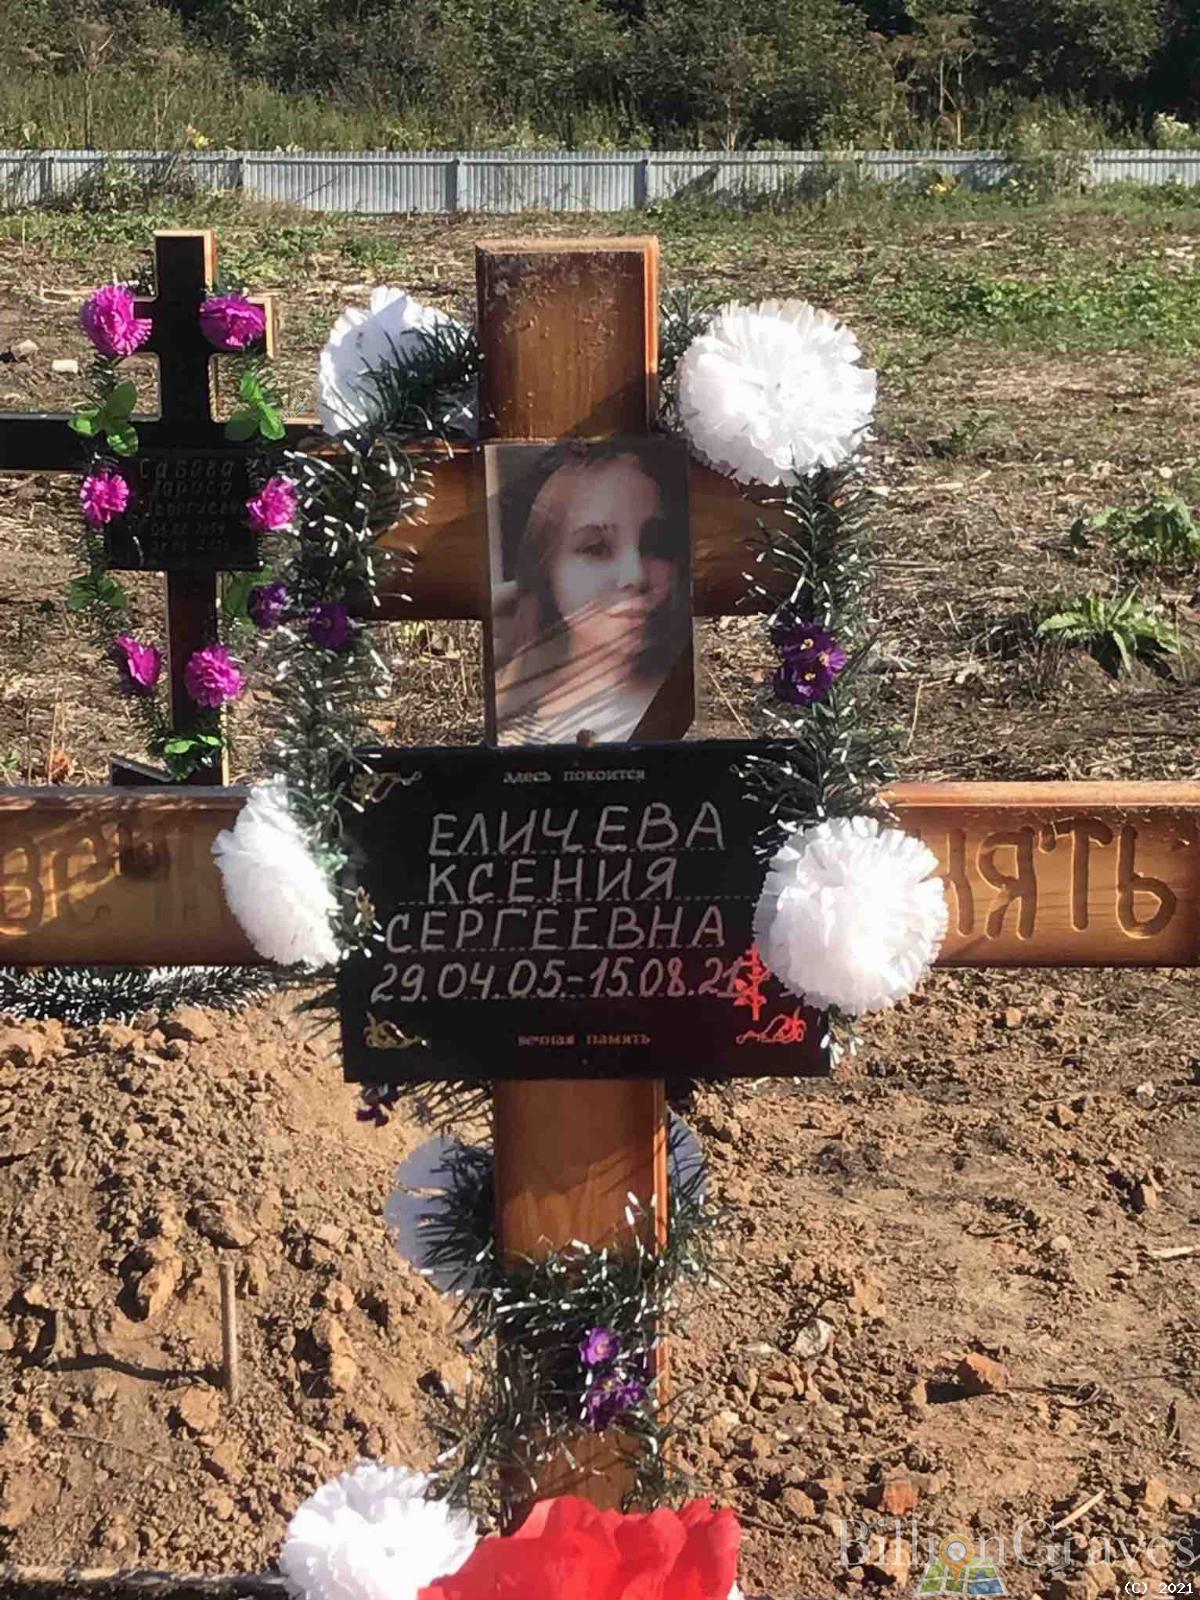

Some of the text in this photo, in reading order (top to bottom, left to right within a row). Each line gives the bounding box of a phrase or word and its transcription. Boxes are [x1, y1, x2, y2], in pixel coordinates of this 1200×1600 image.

[428, 801, 725, 856] ЕЛИЧЕВА
[428, 857, 678, 904] КСЕНИЯ
[385, 904, 726, 953] СЕРГЕЕВНА
